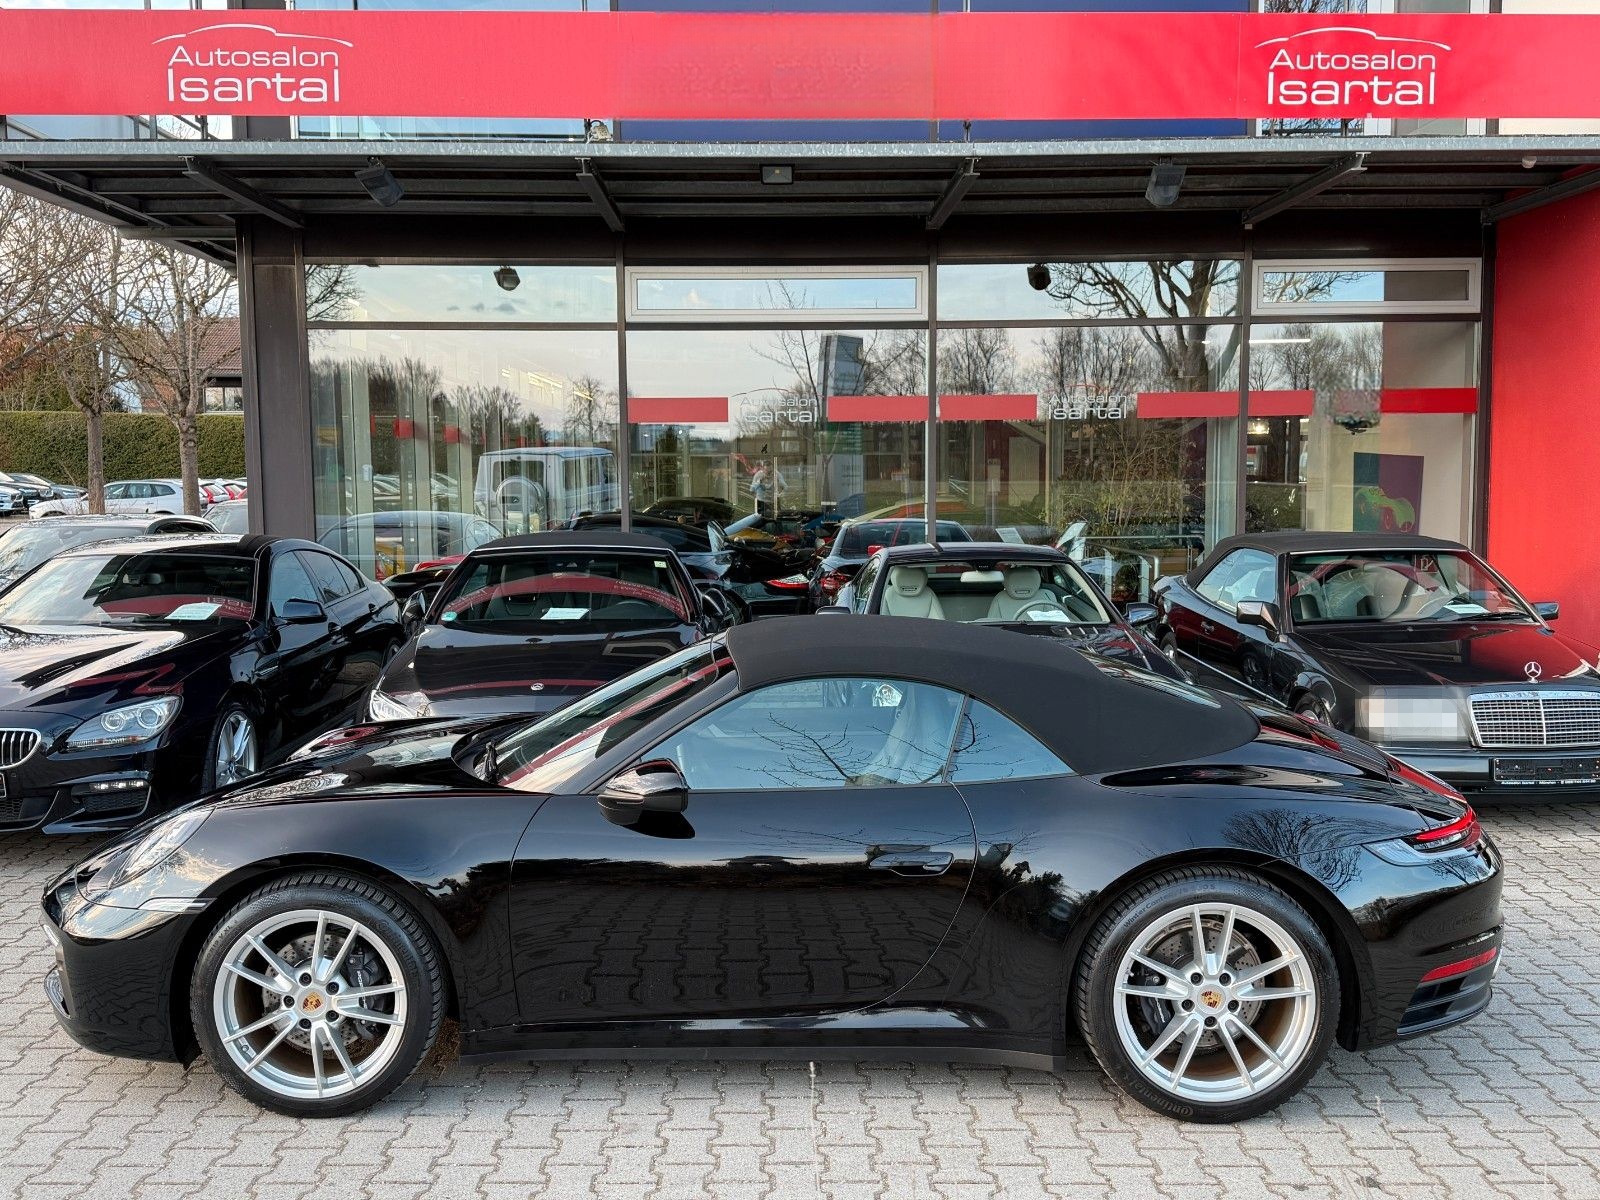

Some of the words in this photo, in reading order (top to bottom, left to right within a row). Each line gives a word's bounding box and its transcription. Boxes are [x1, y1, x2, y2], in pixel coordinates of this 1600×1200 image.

[168, 45, 339, 67] Autosalon
[1269, 48, 1436, 70] Autosalon
[167, 67, 340, 103] Isartal
[1267, 71, 1436, 106] Isartal
[1048, 404, 1127, 420] Isartal
